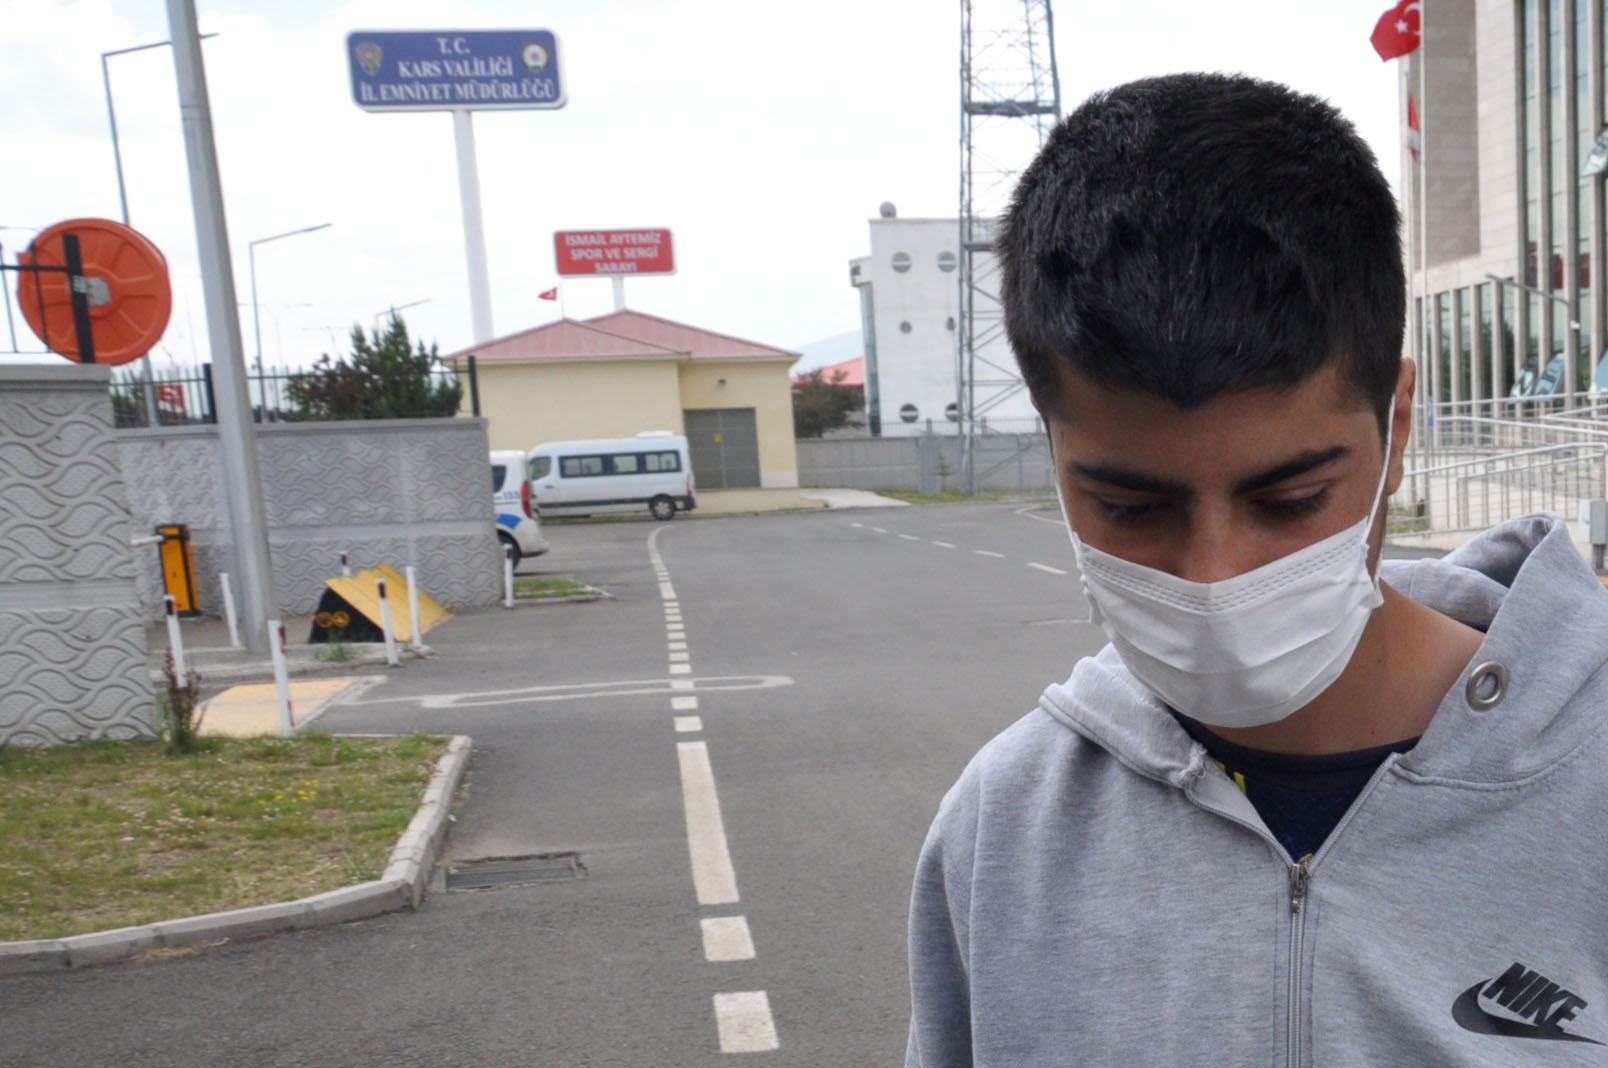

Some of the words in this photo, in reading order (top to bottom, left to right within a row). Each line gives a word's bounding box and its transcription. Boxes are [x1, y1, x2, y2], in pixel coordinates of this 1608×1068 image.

[398, 60, 442, 77] KARS
[444, 56, 514, 77] VALİLİĞİ
[380, 79, 450, 101] EMNİYET
[454, 79, 555, 100] MÜDÜRLÜĞÜ
[570, 247, 604, 260] SPOR
[605, 247, 621, 258] VE
[594, 261, 637, 273] SARAYI
[1481, 962, 1588, 1033] NIKE
